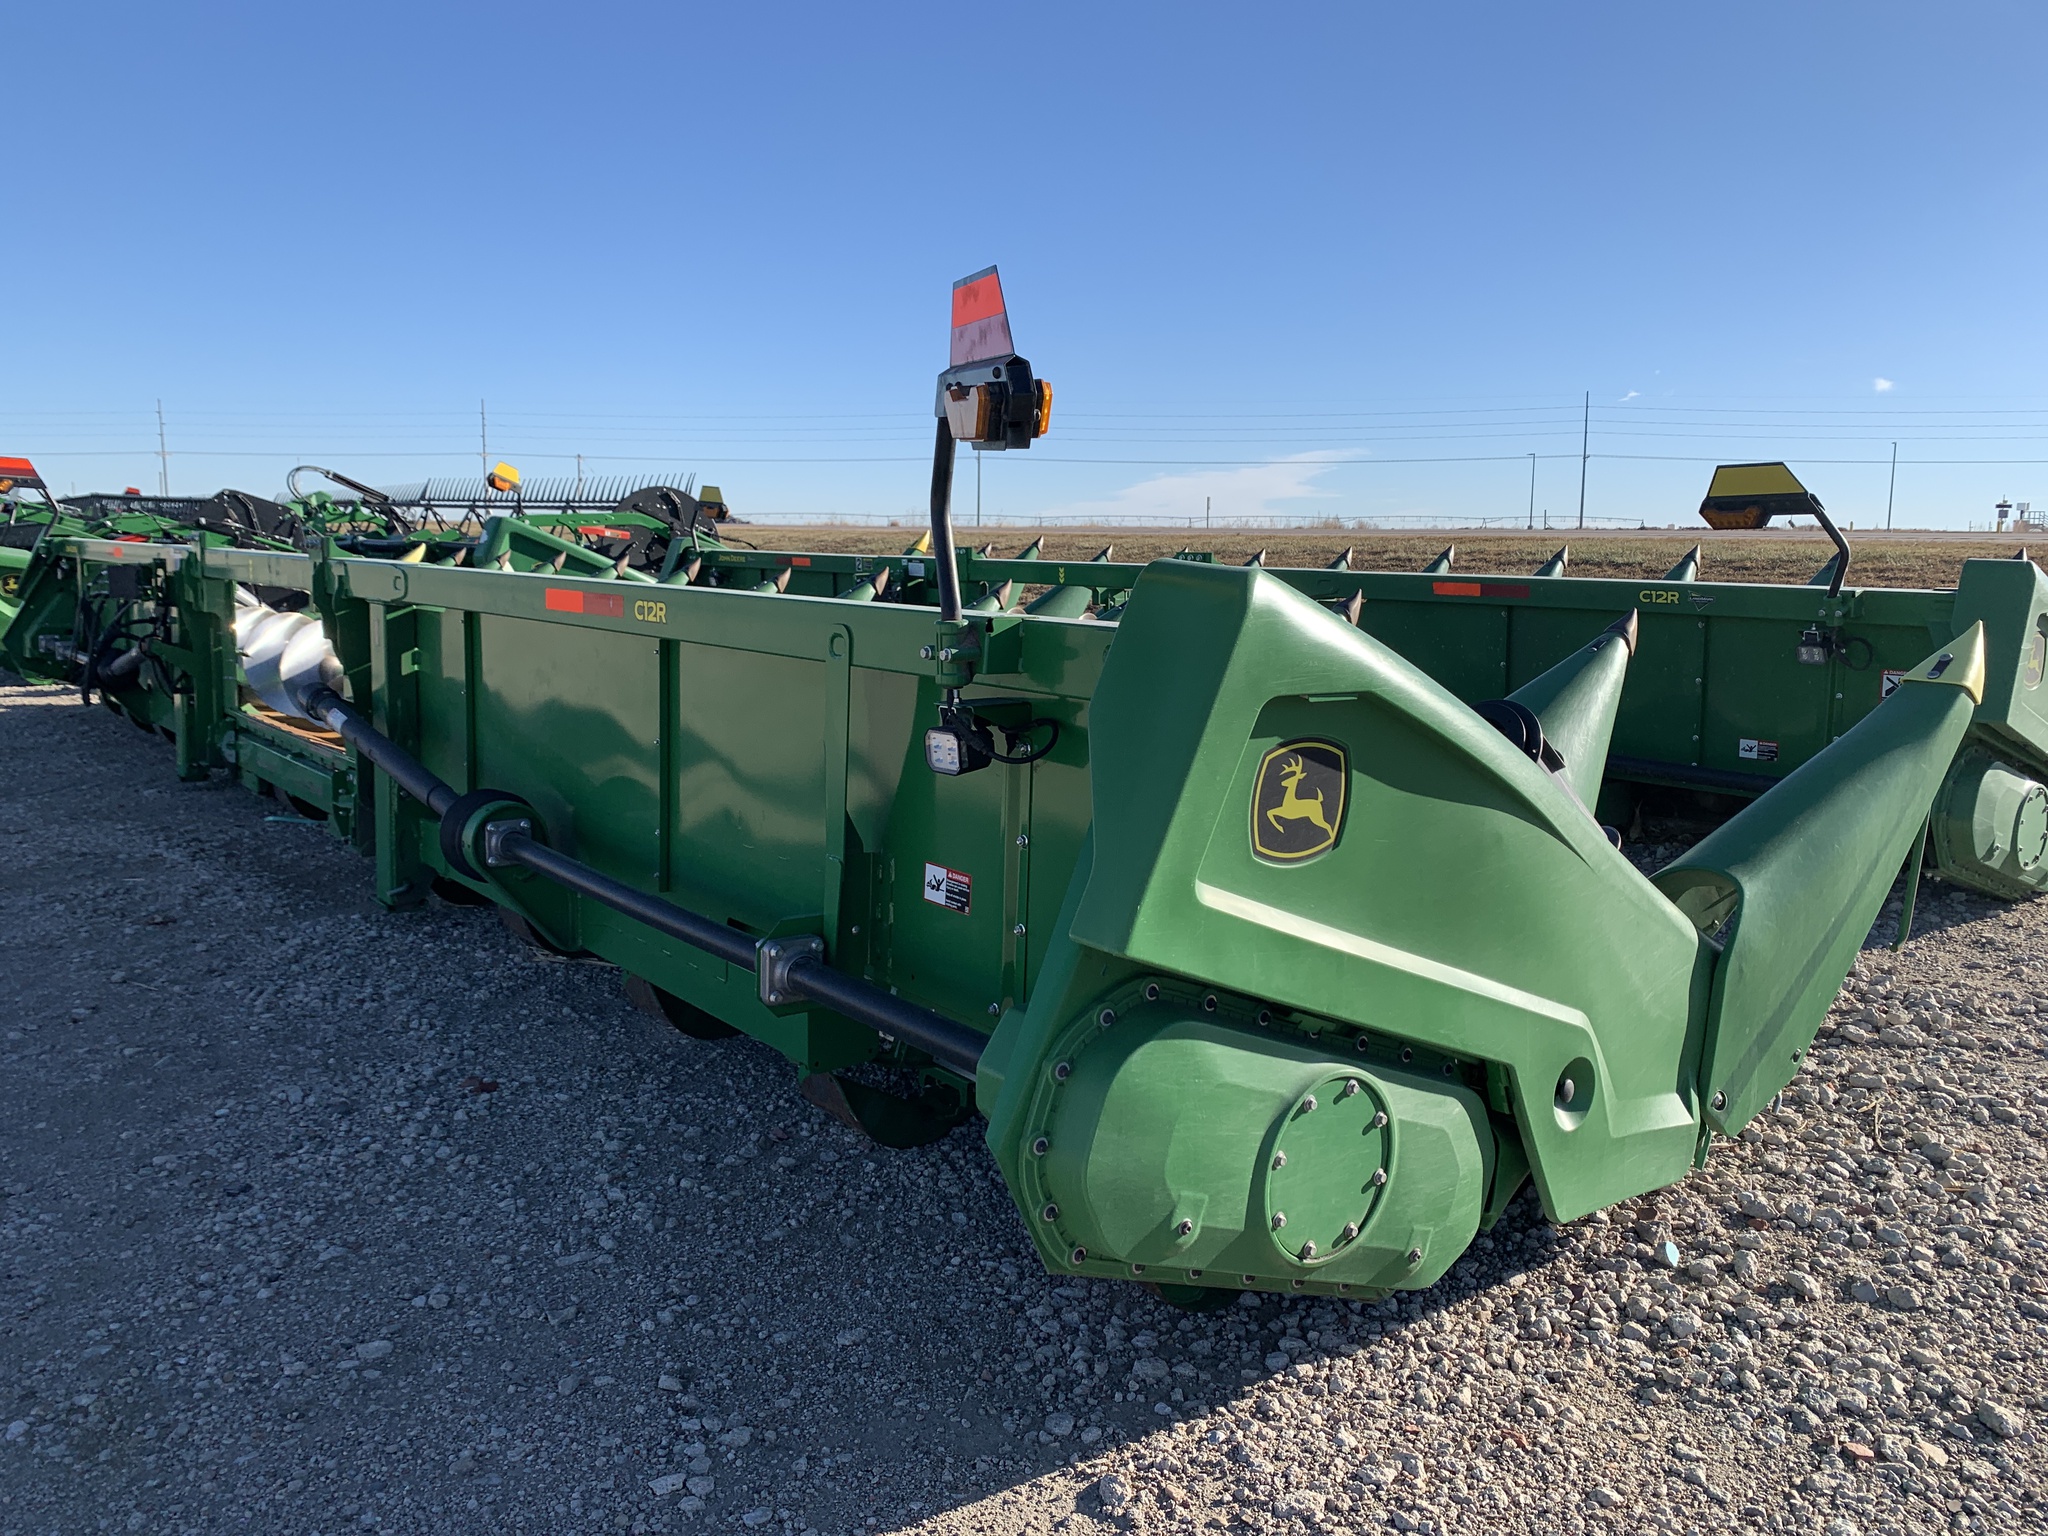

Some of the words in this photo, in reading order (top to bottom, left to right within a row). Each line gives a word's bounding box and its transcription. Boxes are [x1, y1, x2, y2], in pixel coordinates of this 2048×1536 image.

[1639, 590, 1680, 604] C12R
[634, 600, 667, 624] C12R
[952, 872, 969, 883] DANGER
